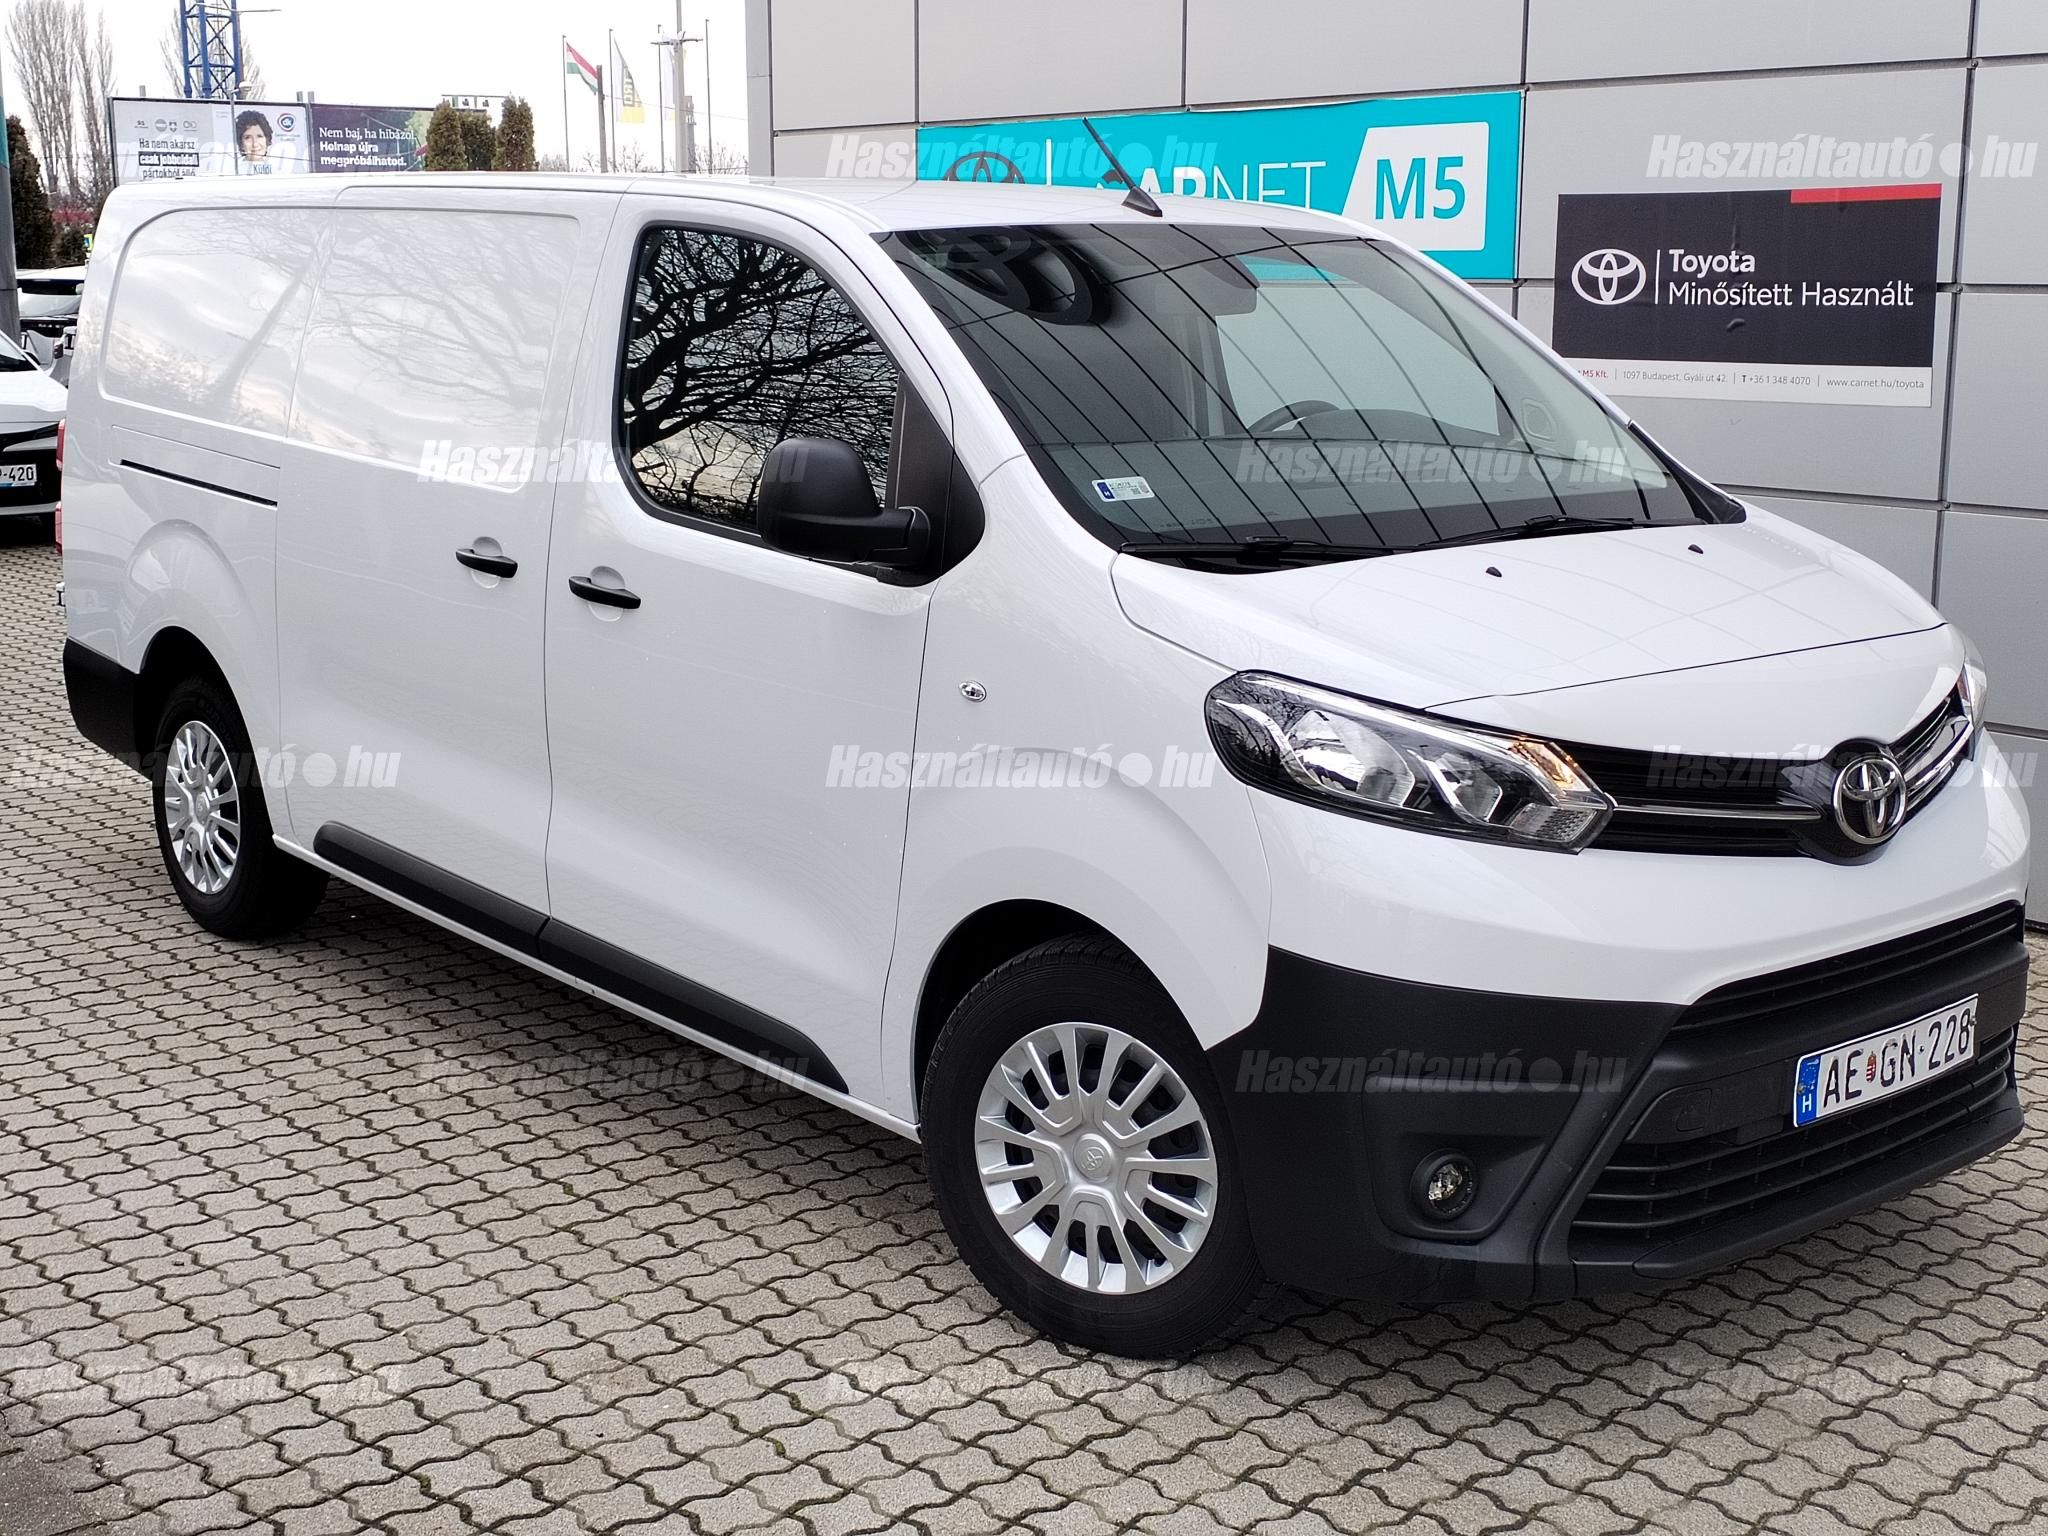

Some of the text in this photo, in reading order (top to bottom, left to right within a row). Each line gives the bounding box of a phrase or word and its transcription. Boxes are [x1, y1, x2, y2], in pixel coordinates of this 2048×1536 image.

[319, 127, 343, 138] Nem
[345, 127, 362, 140] baj,
[364, 128, 377, 139] ha
[139, 137, 195, 150] Ha nem akarsz
[320, 141, 378, 154] Holnap újra
[320, 155, 407, 167] megpróbálhatod.
[1101, 161, 1326, 209] ARNET
[1377, 156, 1465, 220] M5
[1669, 249, 1756, 278] Toyota
[1669, 280, 1914, 306] Minősített Használt
[1583, 370, 1609, 379] M5 Kft.
[1623, 370, 1640, 380] 1097
[1642, 371, 1681, 382] Budapest,
[1742, 375, 1747, 383] T
[1749, 375, 1764, 384] +36
[1772, 376, 1787, 385] 348
[1790, 376, 1811, 385] 4070
[1827, 378, 1925, 389] www.carnet.hu/toyota
[1802, 1094, 1812, 1113] H
[1823, 1049, 1862, 1108] AE
